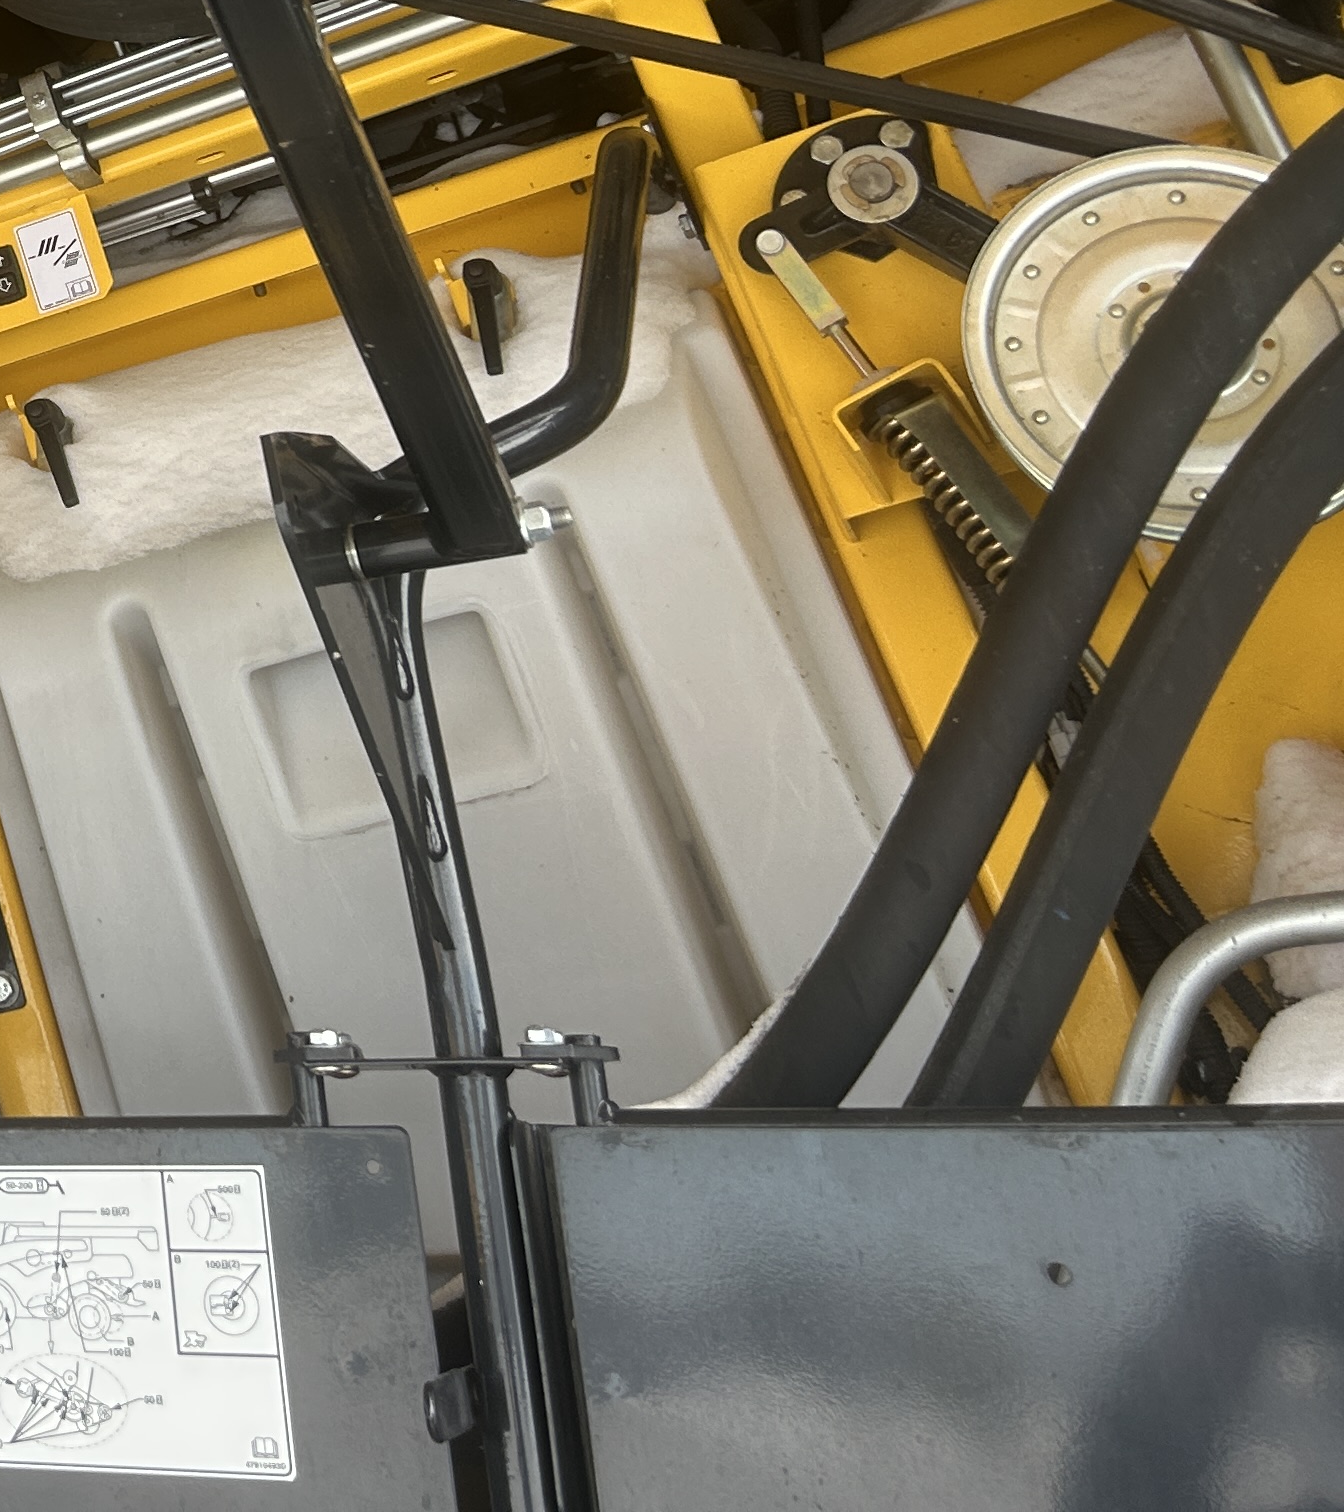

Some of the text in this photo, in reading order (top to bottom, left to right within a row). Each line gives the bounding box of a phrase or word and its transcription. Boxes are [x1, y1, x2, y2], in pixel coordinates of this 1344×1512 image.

[166, 1174, 174, 1184] A
[152, 1311, 160, 1321] A
[127, 1336, 135, 1347] B
